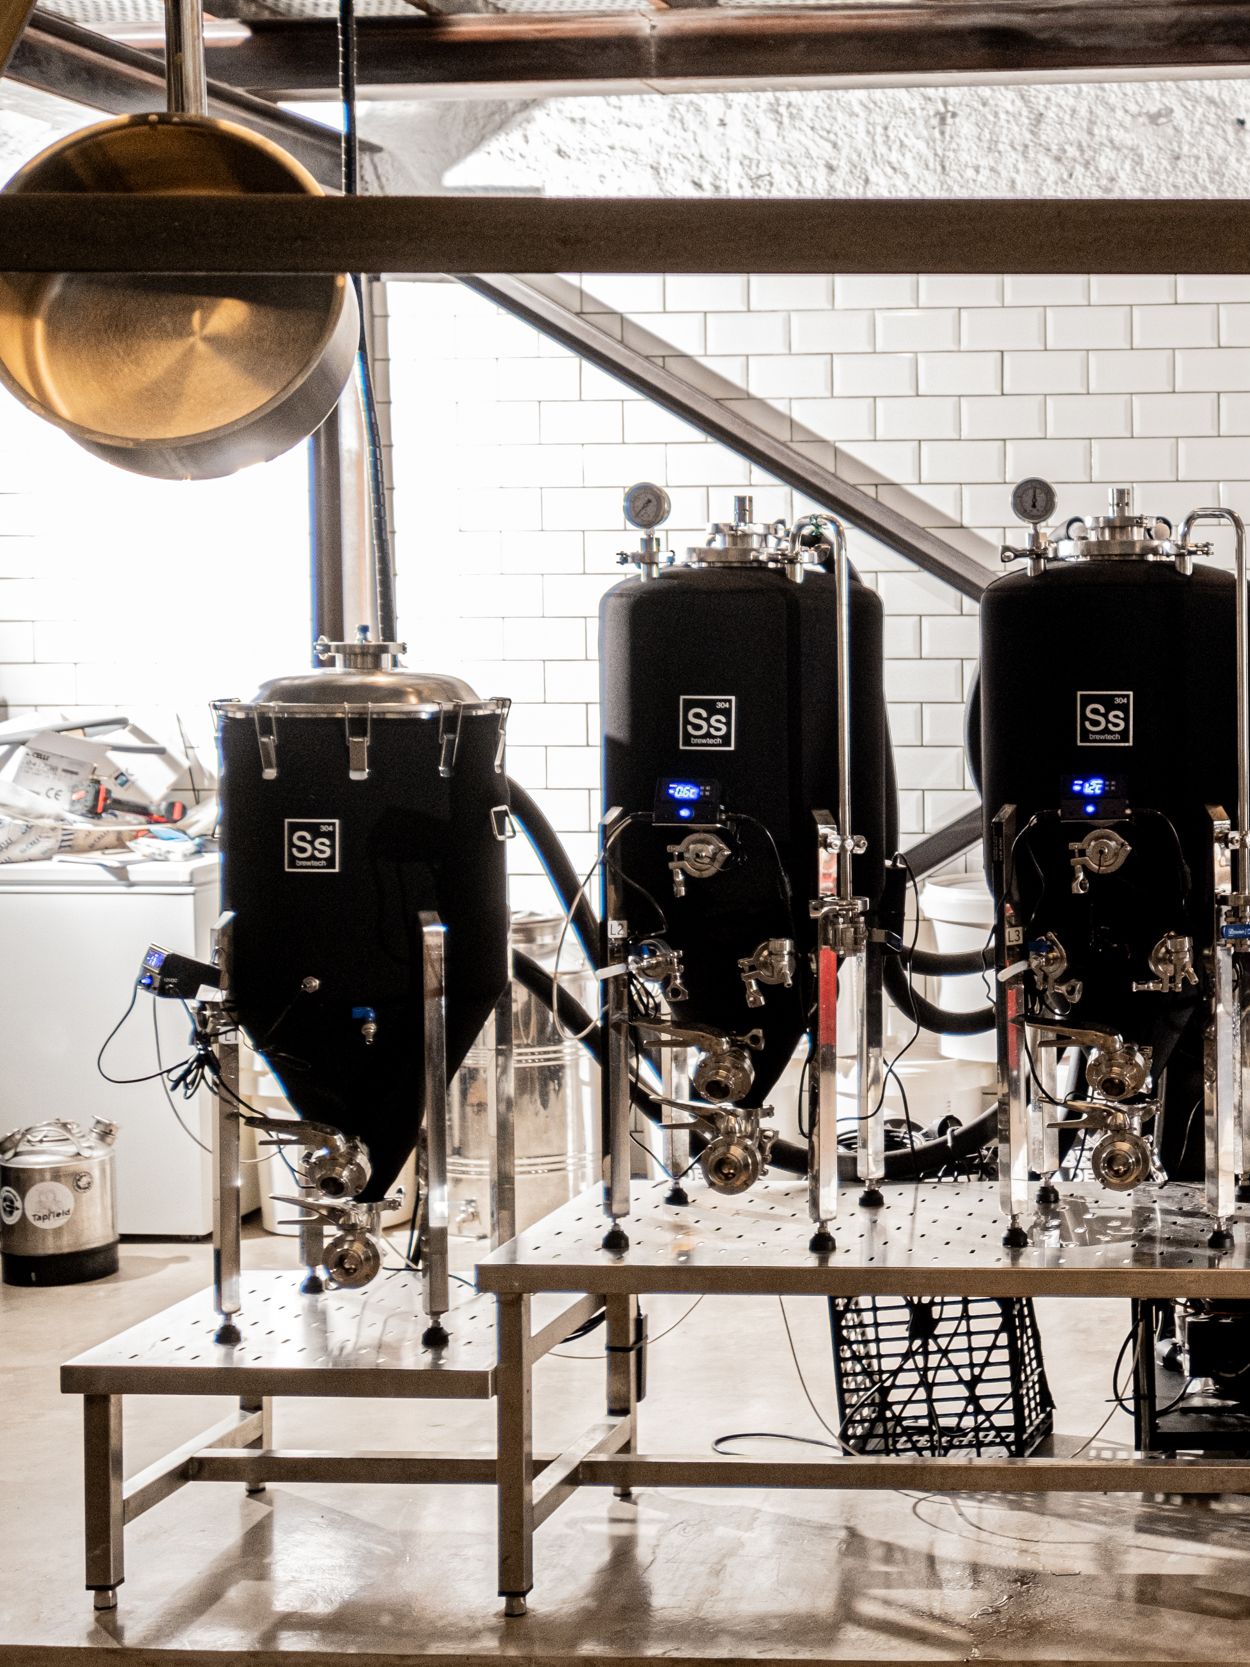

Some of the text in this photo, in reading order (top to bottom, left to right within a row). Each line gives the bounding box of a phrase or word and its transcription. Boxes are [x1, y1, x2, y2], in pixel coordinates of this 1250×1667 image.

[687, 707, 727, 736] Ss
[1084, 703, 1125, 732] Ss
[292, 831, 331, 858] Ss
[610, 923, 624, 936] L2
[1008, 929, 1021, 943] L3
